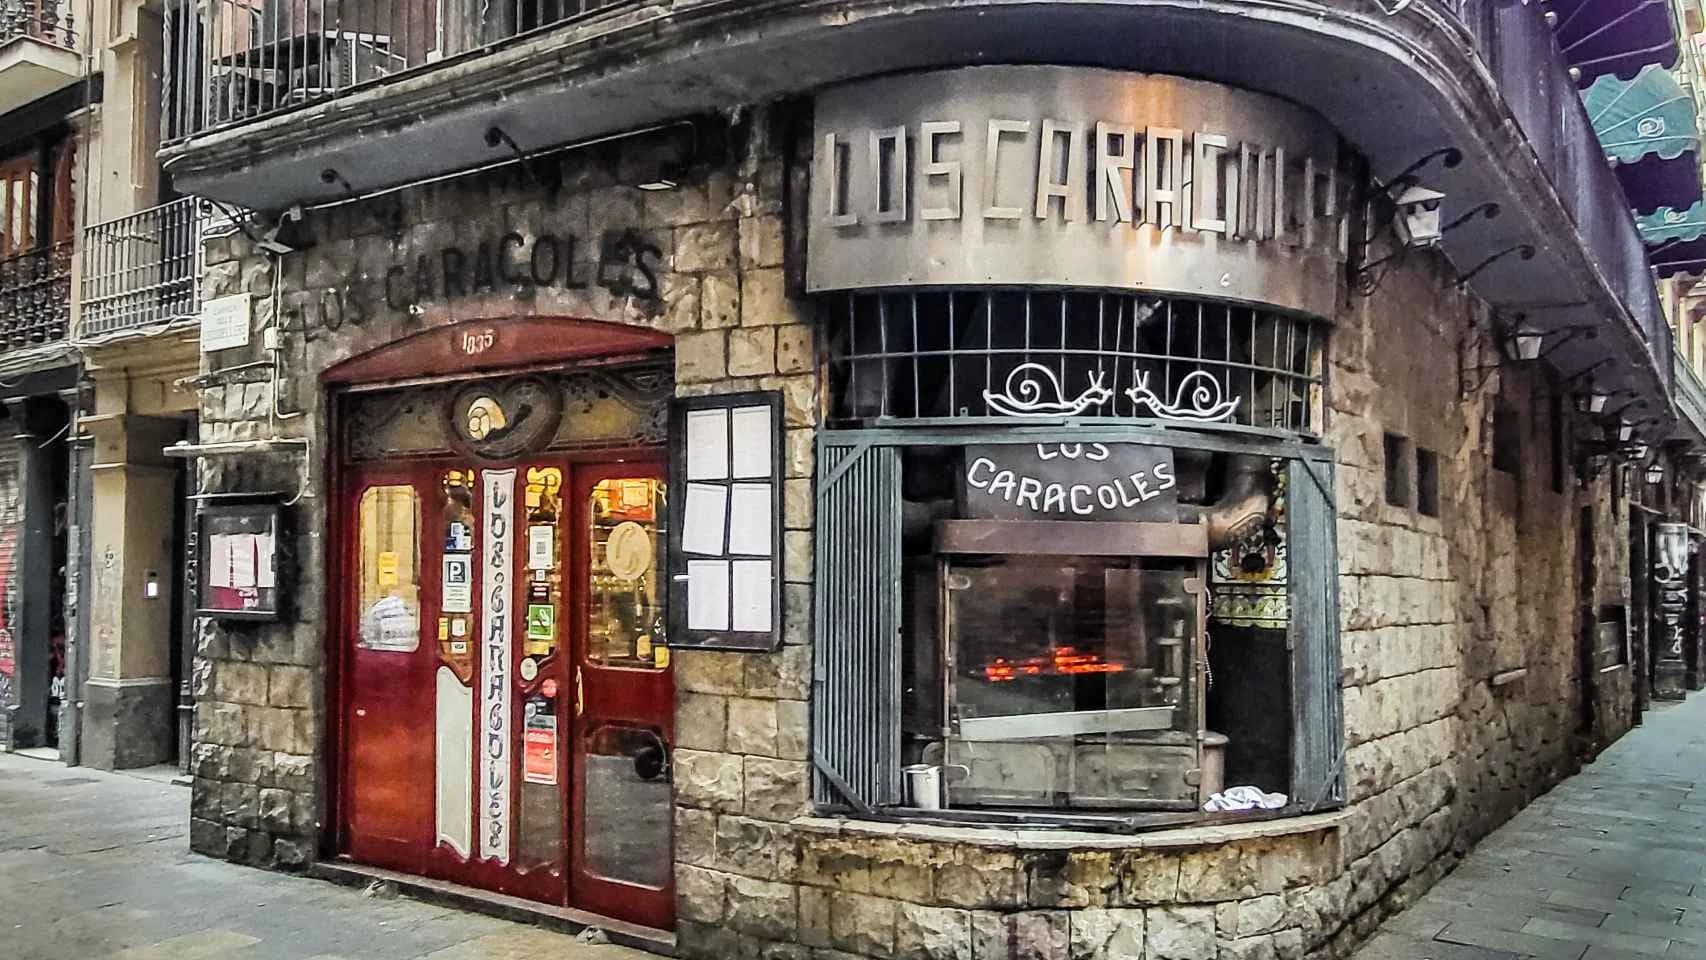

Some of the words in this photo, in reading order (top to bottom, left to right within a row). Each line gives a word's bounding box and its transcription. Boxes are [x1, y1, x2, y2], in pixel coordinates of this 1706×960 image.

[825, 119, 962, 226] LOS
[385, 230, 664, 314] CARACOLES
[462, 328, 494, 355] 1835
[967, 457, 1176, 515] CARACOLES
